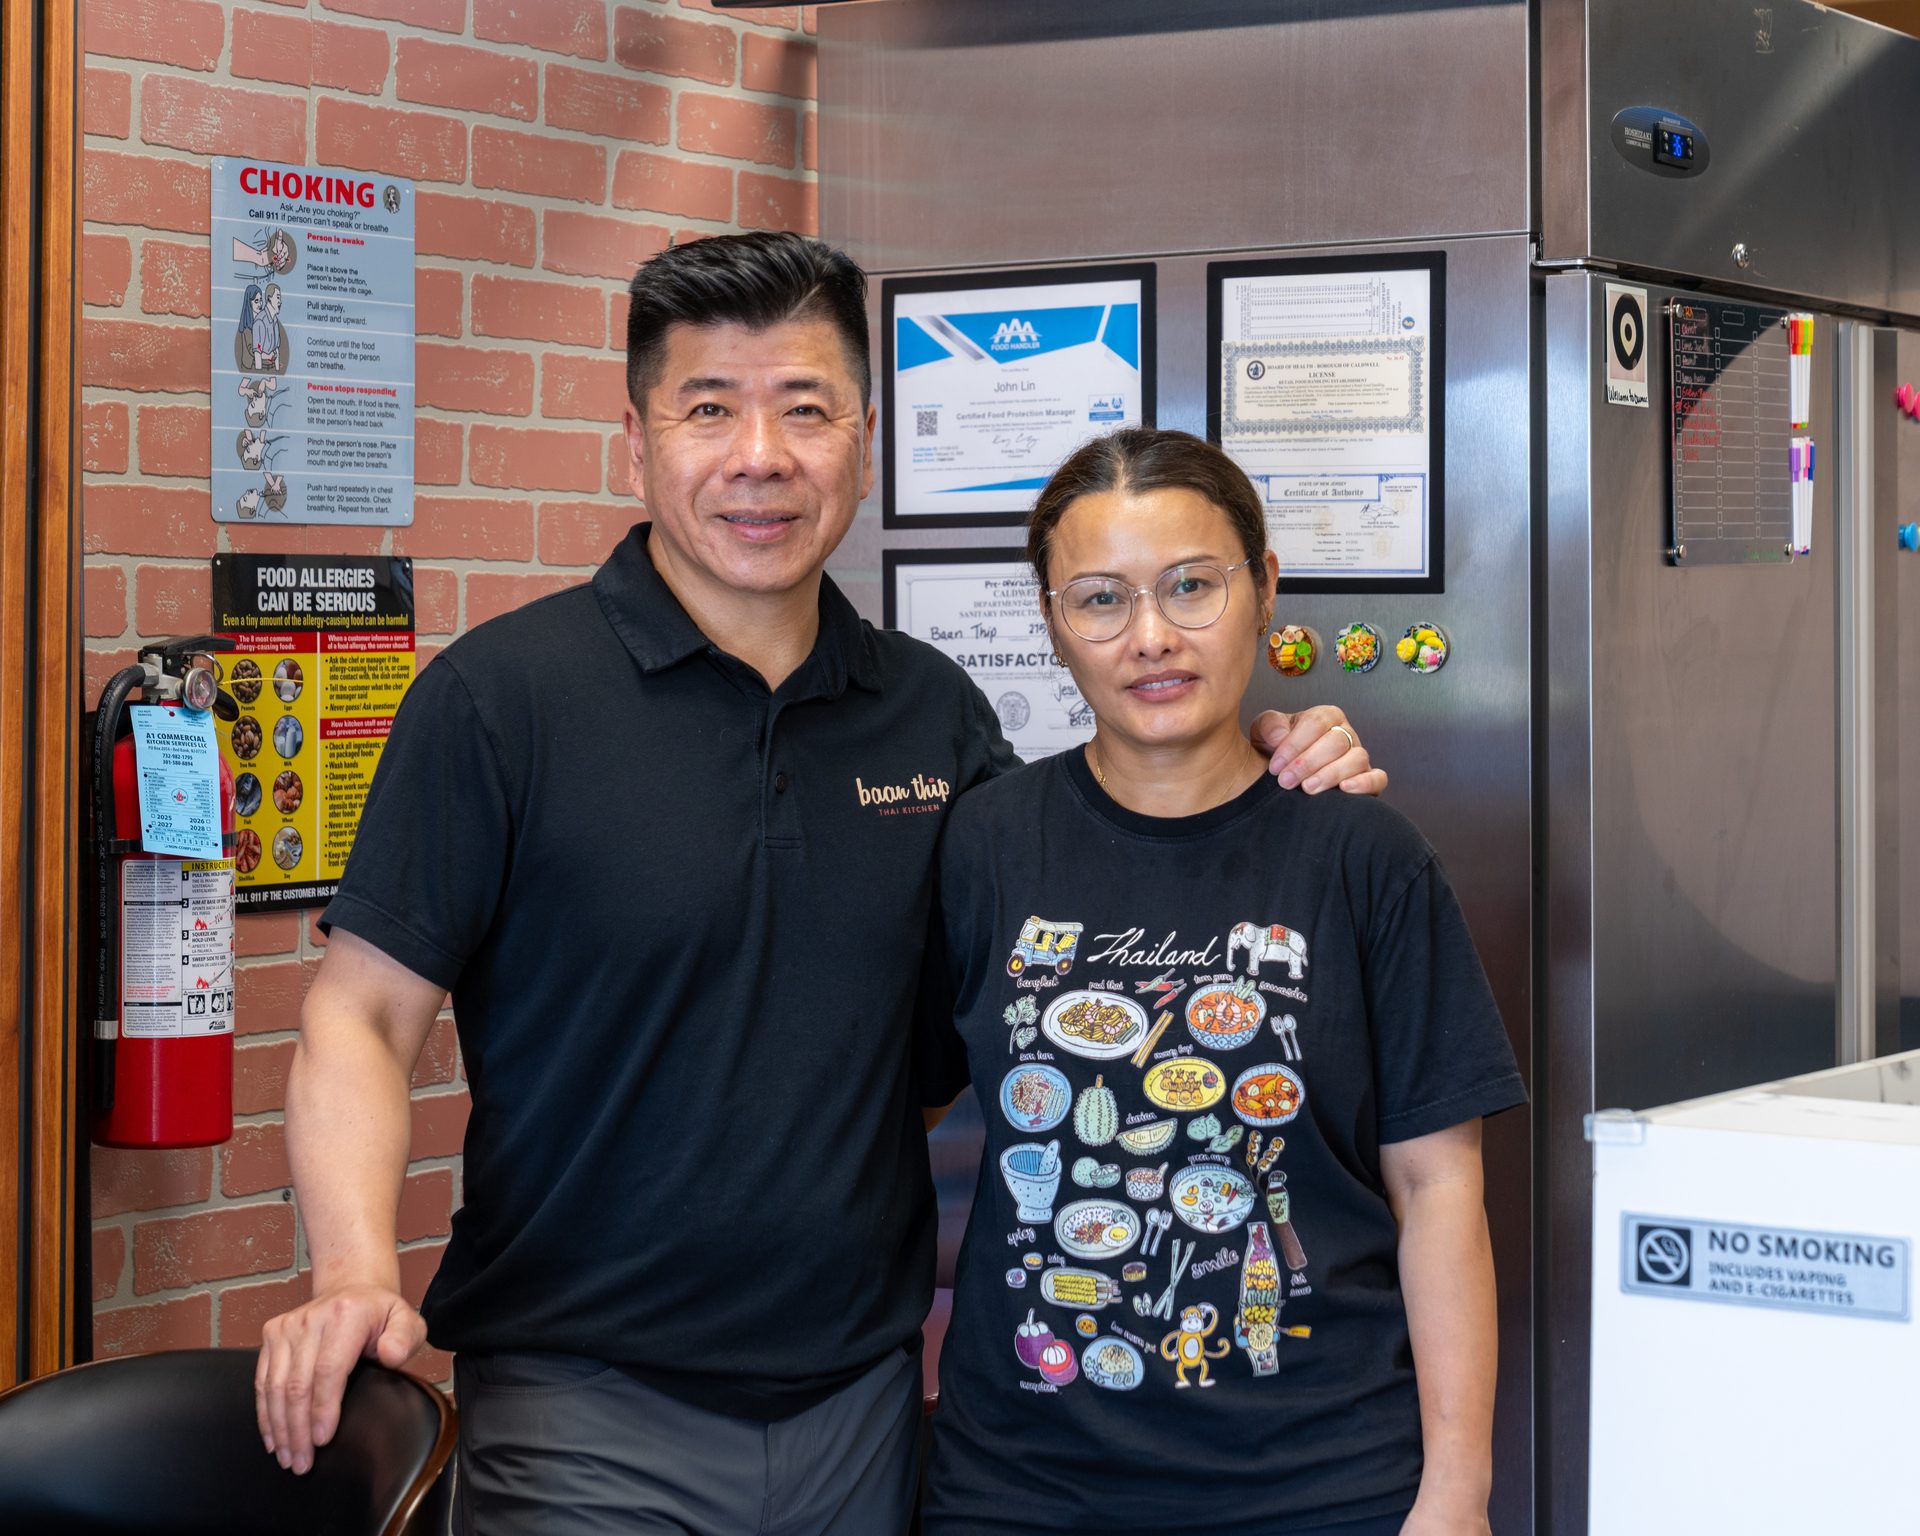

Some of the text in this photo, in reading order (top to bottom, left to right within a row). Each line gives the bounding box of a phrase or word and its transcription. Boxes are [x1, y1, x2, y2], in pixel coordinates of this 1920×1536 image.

[240, 167, 374, 208] CHOKING
[280, 202, 294, 211] Ask
[312, 208, 325, 216] you
[249, 209, 264, 219] Call
[265, 211, 279, 220] 911
[281, 213, 286, 221] if
[287, 215, 312, 224] person
[313, 217, 330, 226] can't
[332, 220, 353, 229] speak
[363, 221, 388, 232] breathe
[307, 233, 333, 242] Person
[307, 245, 324, 253] Make
[307, 263, 324, 271] Place
[333, 275, 347, 284] belly
[348, 277, 367, 285] button,
[320, 283, 337, 291] below
[307, 301, 345, 314] Pull sharply,
[307, 312, 328, 320] inward
[994, 318, 1038, 343] AAA
[307, 336, 375, 349] Continue until the food
[991, 342, 1040, 351] FOOD HANDLER
[359, 353, 380, 361] person
[320, 361, 345, 369] breathe.
[307, 382, 396, 396] Person stops responding
[994, 381, 1035, 392] John Lin
[956, 412, 986, 420] Certified
[1007, 410, 1043, 418] Protection
[1046, 409, 1076, 418] Manager
[1284, 489, 1318, 497] Certificate
[258, 567, 375, 588] FOOD ALLERGIES
[258, 591, 376, 612] CAN BE SERIOUS
[974, 600, 1021, 608] DEPARTMENT
[224, 614, 409, 628] Even a tiny amount of the allergy-causing food can be harmful
[971, 623, 997, 643] Thip
[236, 642, 279, 651] allergy-causing
[956, 654, 1057, 667] SATISFACTO
[157, 733, 206, 742] COMMERCIAL
[171, 740, 199, 748] SERVICES
[856, 774, 949, 806] baan thip
[903, 804, 939, 814] KITCHEN
[251, 892, 261, 902] 911
[263, 892, 269, 901] IF
[270, 890, 281, 900] THE
[283, 888, 316, 900] CUSTOMER
[317, 887, 329, 898] HAS
[1087, 927, 1222, 966] Thailand
[183, 956, 188, 964] 4
[1088, 980, 1124, 991] pad thai
[1007, 1226, 1036, 1247] spicy
[1709, 1229, 1895, 1268] NO SMOKING
[1192, 1247, 1239, 1279] smile
[1709, 1262, 1847, 1288] INCLUDES VAPING
[1710, 1281, 1854, 1306] AND E-CIGARETTES
